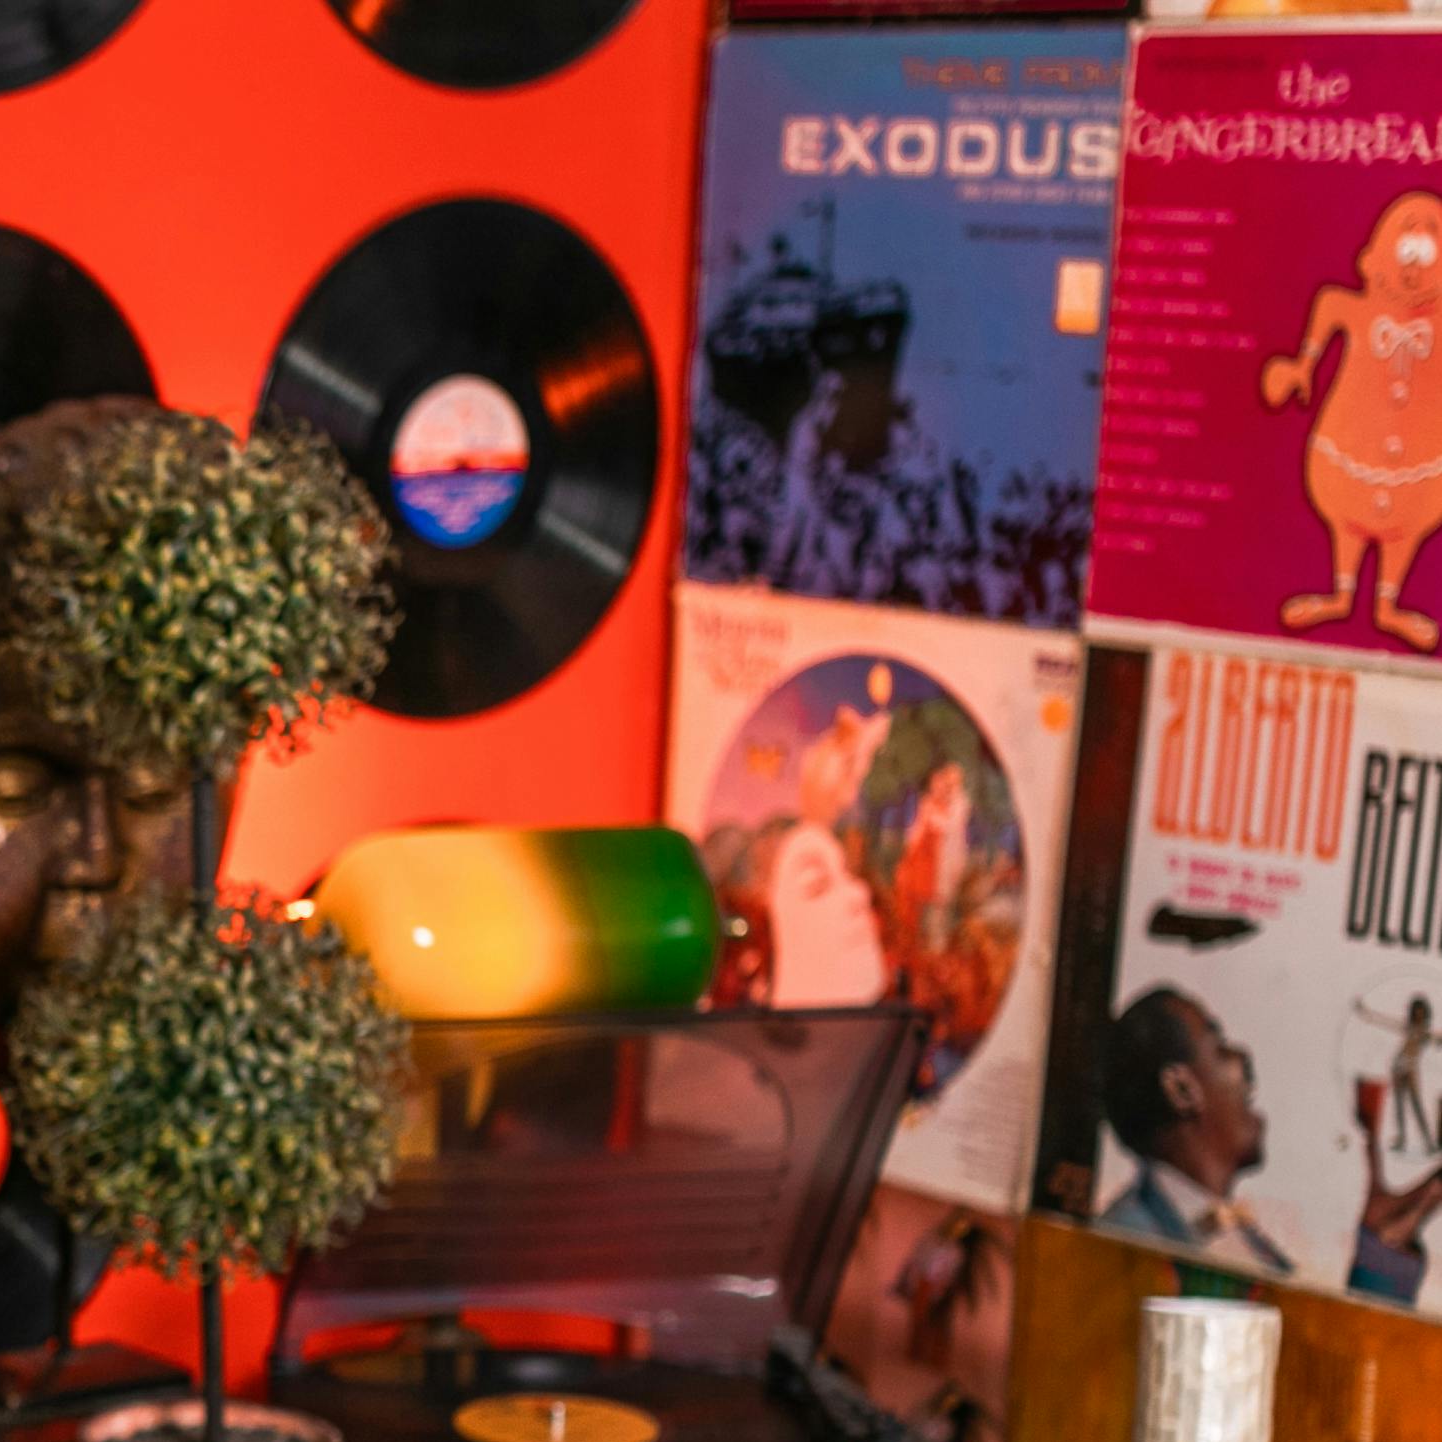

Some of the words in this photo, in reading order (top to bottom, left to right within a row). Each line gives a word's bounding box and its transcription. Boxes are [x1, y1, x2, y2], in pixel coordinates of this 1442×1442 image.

[1277, 64, 1351, 107] the
[781, 118, 1121, 180] EXODUS
[1129, 110, 1442, 165] GINGERBREA
[1346, 750, 1442, 952] BELT
